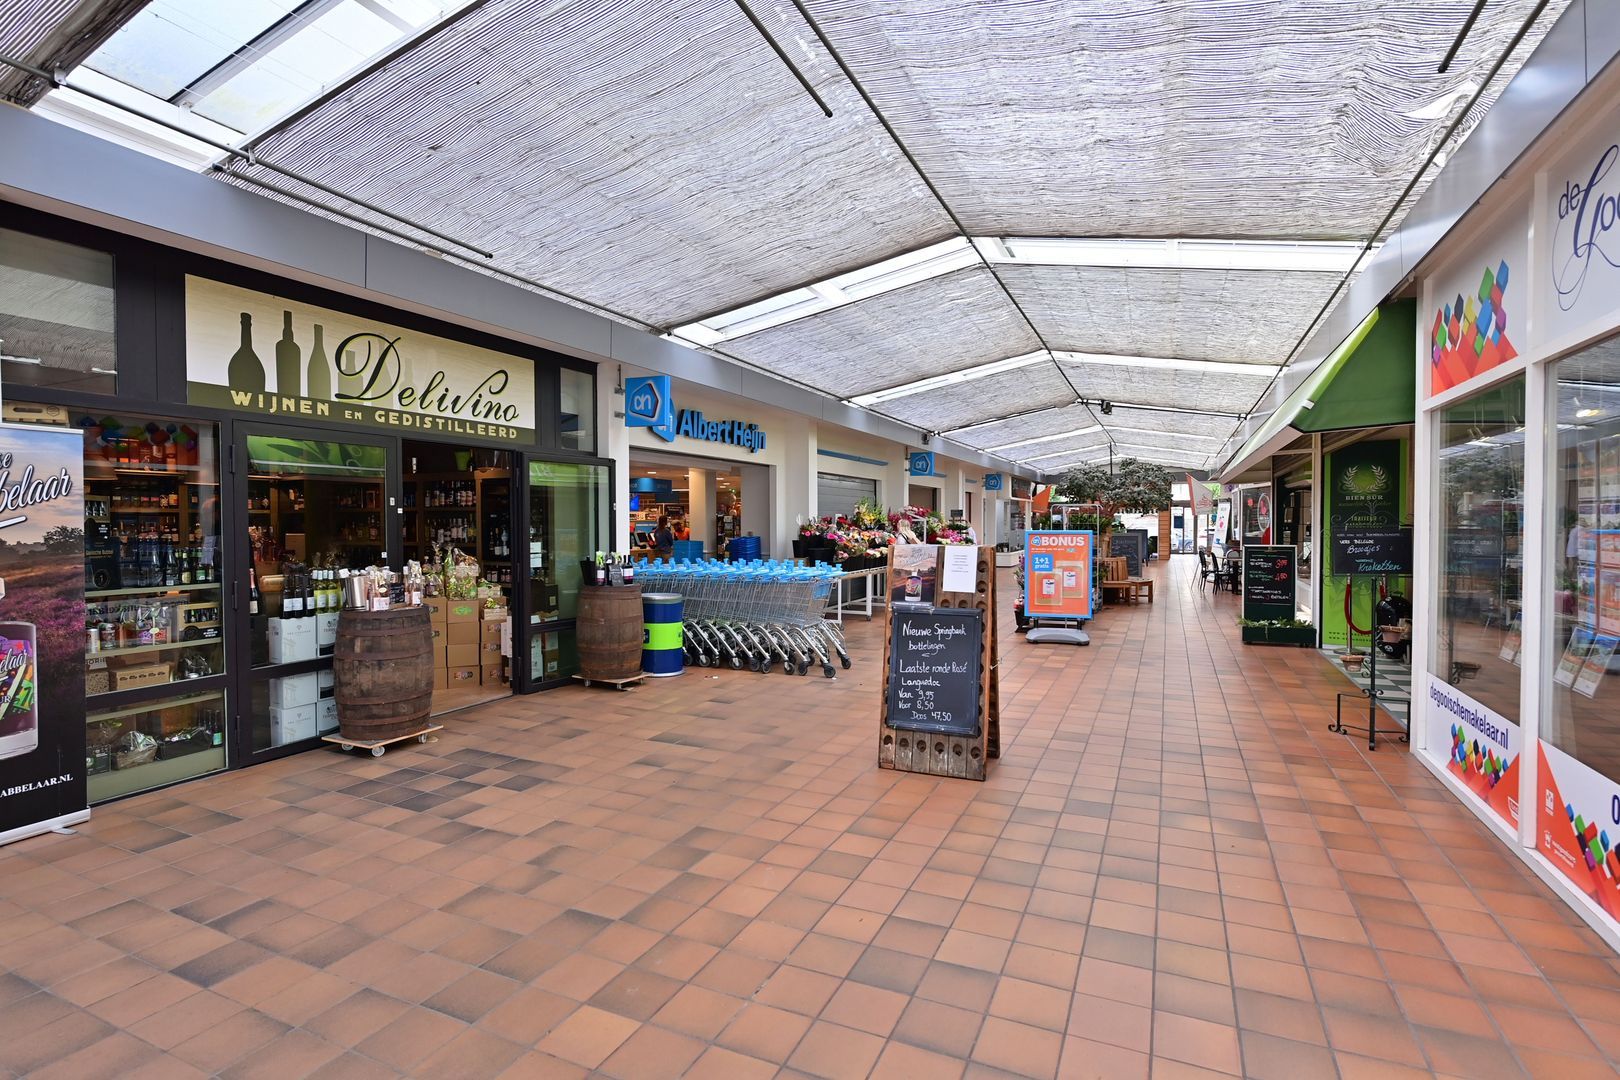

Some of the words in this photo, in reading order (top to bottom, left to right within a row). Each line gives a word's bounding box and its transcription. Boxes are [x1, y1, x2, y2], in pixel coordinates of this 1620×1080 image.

[1558, 181, 1581, 220] de
[335, 333, 519, 421] Delivino
[230, 390, 329, 416] WIJNEN
[344, 410, 362, 420] EN
[374, 410, 517, 439] GEDISTILLEERD
[679, 409, 732, 444] Albert
[733, 420, 767, 453] Heijn
[1041, 536, 1085, 546] BONUS
[902, 620, 932, 636] Nieuwe
[934, 623, 967, 640] Springbank
[899, 659, 930, 673] Laatste
[932, 662, 951, 673] ronde
[951, 661, 968, 673] Rosé
[901, 676, 941, 691] Languedoc
[898, 688, 913, 698] Van
[918, 690, 934, 701] 9,95
[898, 700, 911, 709] Voor
[916, 700, 934, 710] 8,50
[910, 710, 927, 720] Doos
[1430, 682, 1508, 750] degooischemakelaar.nl
